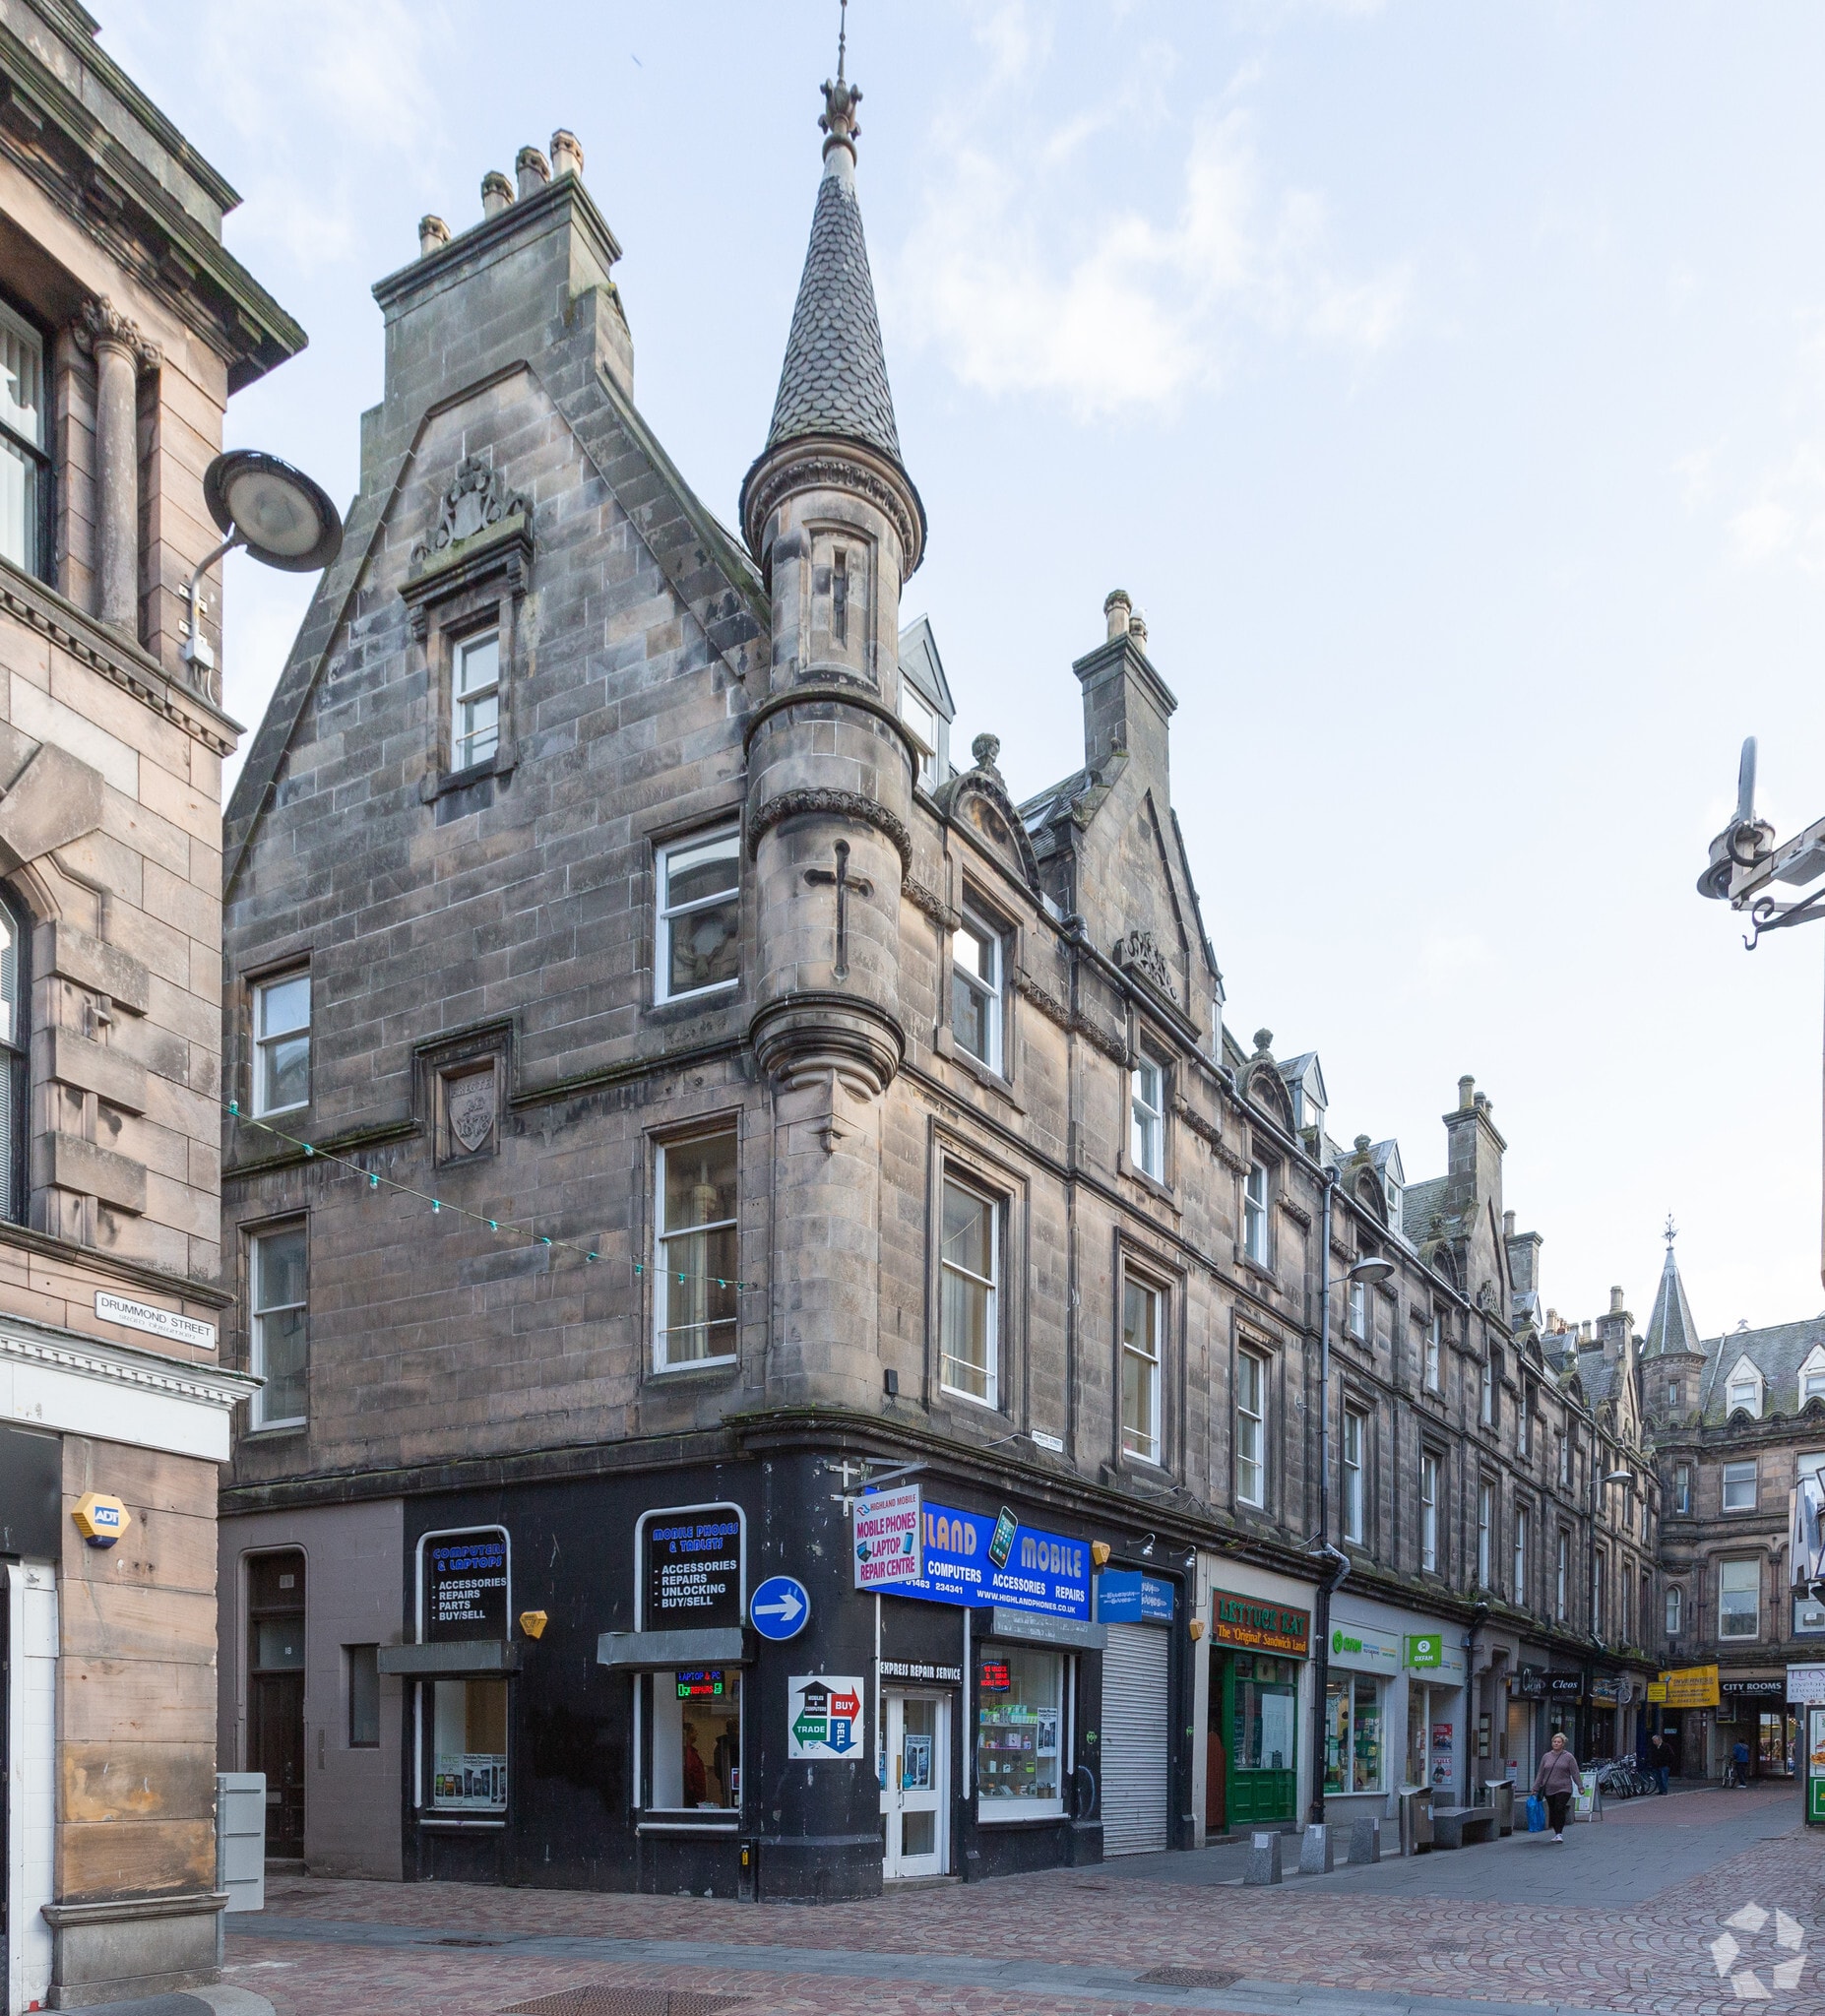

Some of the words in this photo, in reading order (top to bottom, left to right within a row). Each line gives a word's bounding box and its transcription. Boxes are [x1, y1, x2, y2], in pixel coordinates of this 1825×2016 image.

[100, 1296, 167, 1324] DRUMMOND
[171, 1317, 212, 1337] STREET
[869, 1498, 896, 1512] HIGHLAND
[897, 1493, 916, 1507] MOBILE
[95, 1510, 119, 1524] ADT
[653, 1527, 693, 1542] MOBILE
[696, 1522, 738, 1537] PHONES
[856, 1517, 885, 1540] MOBILE
[885, 1511, 916, 1534] PHONES
[433, 1544, 506, 1559] COMPUTERS
[669, 1541, 677, 1553] &
[680, 1537, 724, 1552] TABLETS
[872, 1537, 901, 1557] LAPTOP
[922, 1512, 977, 1556] LAND
[1021, 1536, 1082, 1579] MOBILE
[437, 1560, 446, 1572] &
[450, 1555, 503, 1570] LAPTOPS
[661, 1560, 737, 1575] ACCESSORIES
[860, 1560, 886, 1581] REPAIR
[886, 1556, 915, 1577] CENTRE
[439, 1577, 507, 1591] ACCESSORIES
[661, 1574, 708, 1586] REPAIRS
[927, 1560, 982, 1584] COMPUTERS
[992, 1572, 1046, 1596] ACCESSORIES
[1055, 1585, 1085, 1603] REPAIRS
[439, 1590, 480, 1601] REPAIRS
[661, 1584, 726, 1597] UNLOCKING
[935, 1582, 964, 1595] 234341
[439, 1601, 471, 1610] PARTS
[661, 1596, 714, 1607] BUY/SELL
[976, 1589, 1076, 1614] WWW.HIGHLANDPHONES.CO.UK
[439, 1610, 486, 1621] BUY/SELL
[1220, 1597, 1277, 1631] LETTUCE
[1281, 1611, 1305, 1636] EAT
[1218, 1624, 1230, 1639] The
[1263, 1633, 1291, 1650] Sandwich
[1292, 1639, 1306, 1653] Land
[678, 1671, 704, 1681] LAPTOP
[711, 1671, 721, 1680] PC
[880, 1661, 909, 1675] EXPRESS
[910, 1664, 934, 1678] REPAIR
[936, 1666, 961, 1680] SERVICE
[1551, 1679, 1578, 1689] Cleos
[1723, 1682, 1745, 1691] CITY
[1746, 1682, 1782, 1691] ROOMS
[835, 1701, 854, 1710] BUY
[837, 1722, 846, 1746] SELL
